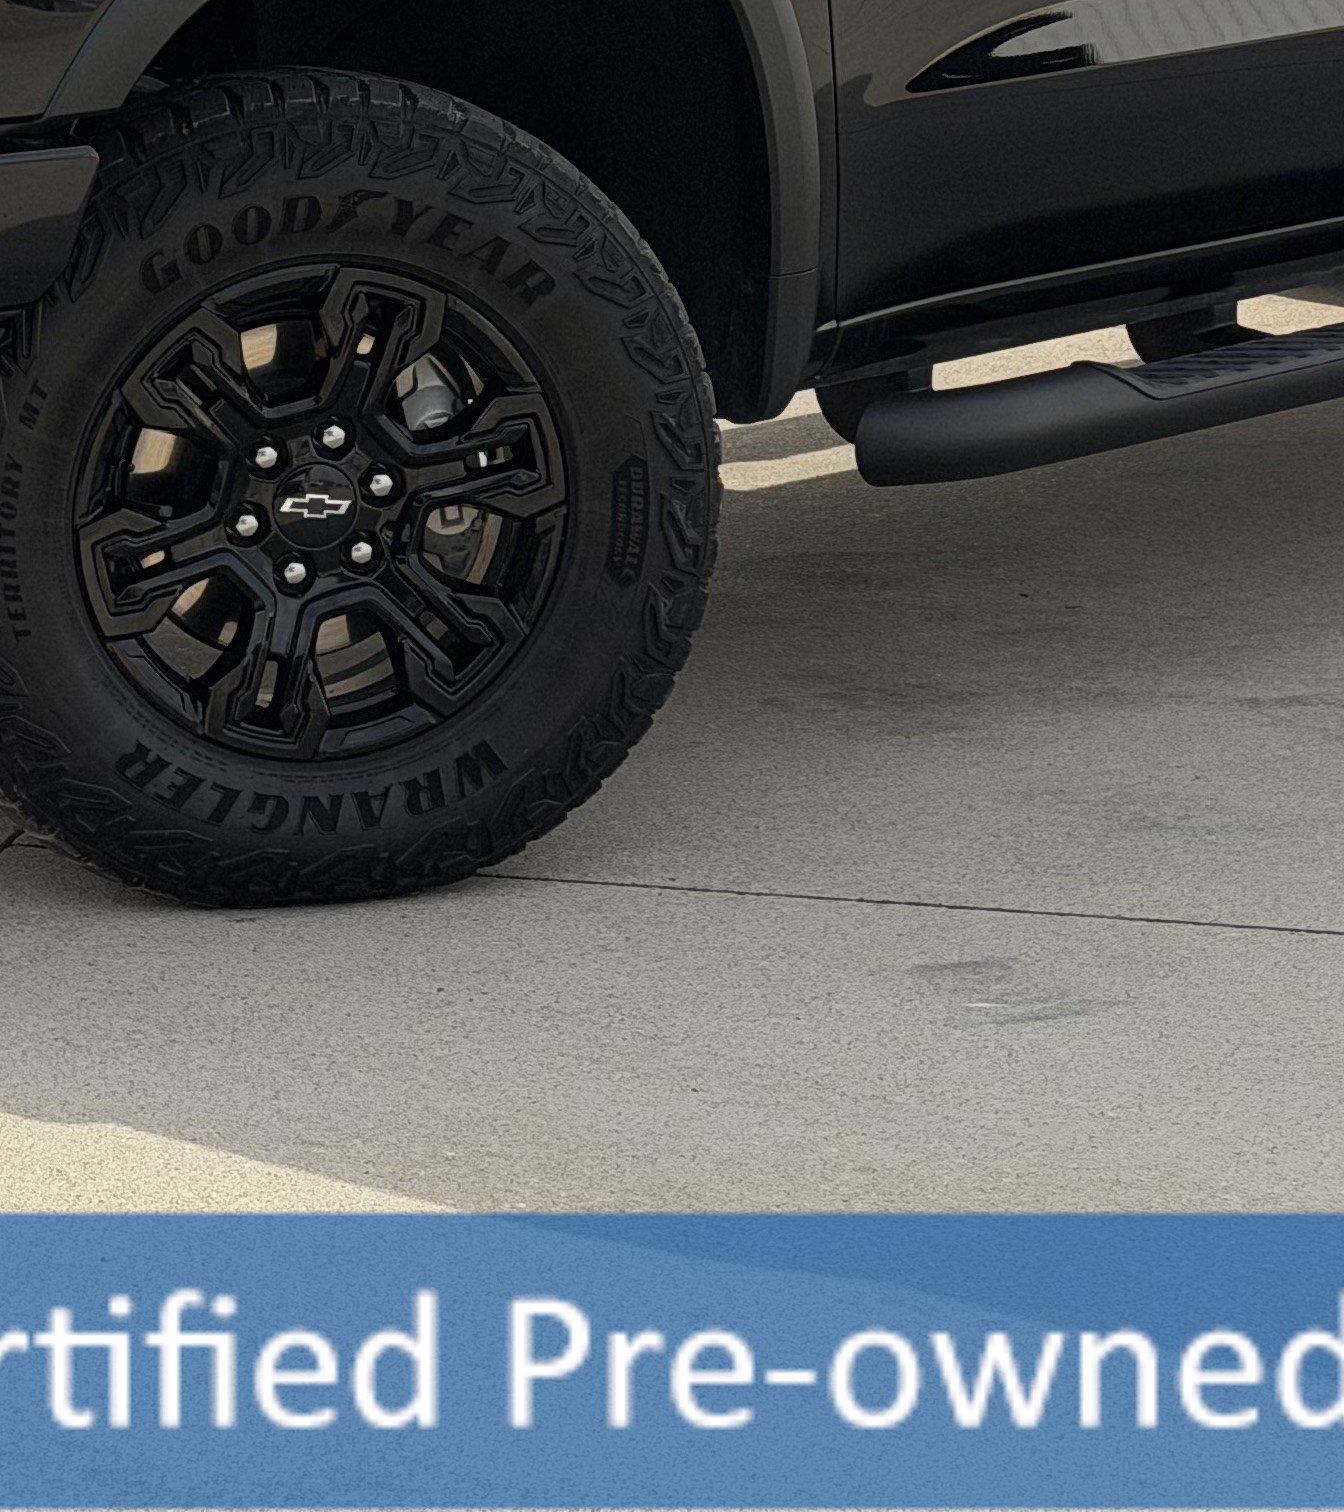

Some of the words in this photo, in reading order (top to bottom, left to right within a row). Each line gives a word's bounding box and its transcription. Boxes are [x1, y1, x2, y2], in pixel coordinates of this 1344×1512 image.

[139, 189, 558, 310] GOODYEAR
[18, 379, 48, 430] MT
[114, 739, 508, 836] WRANGLER
